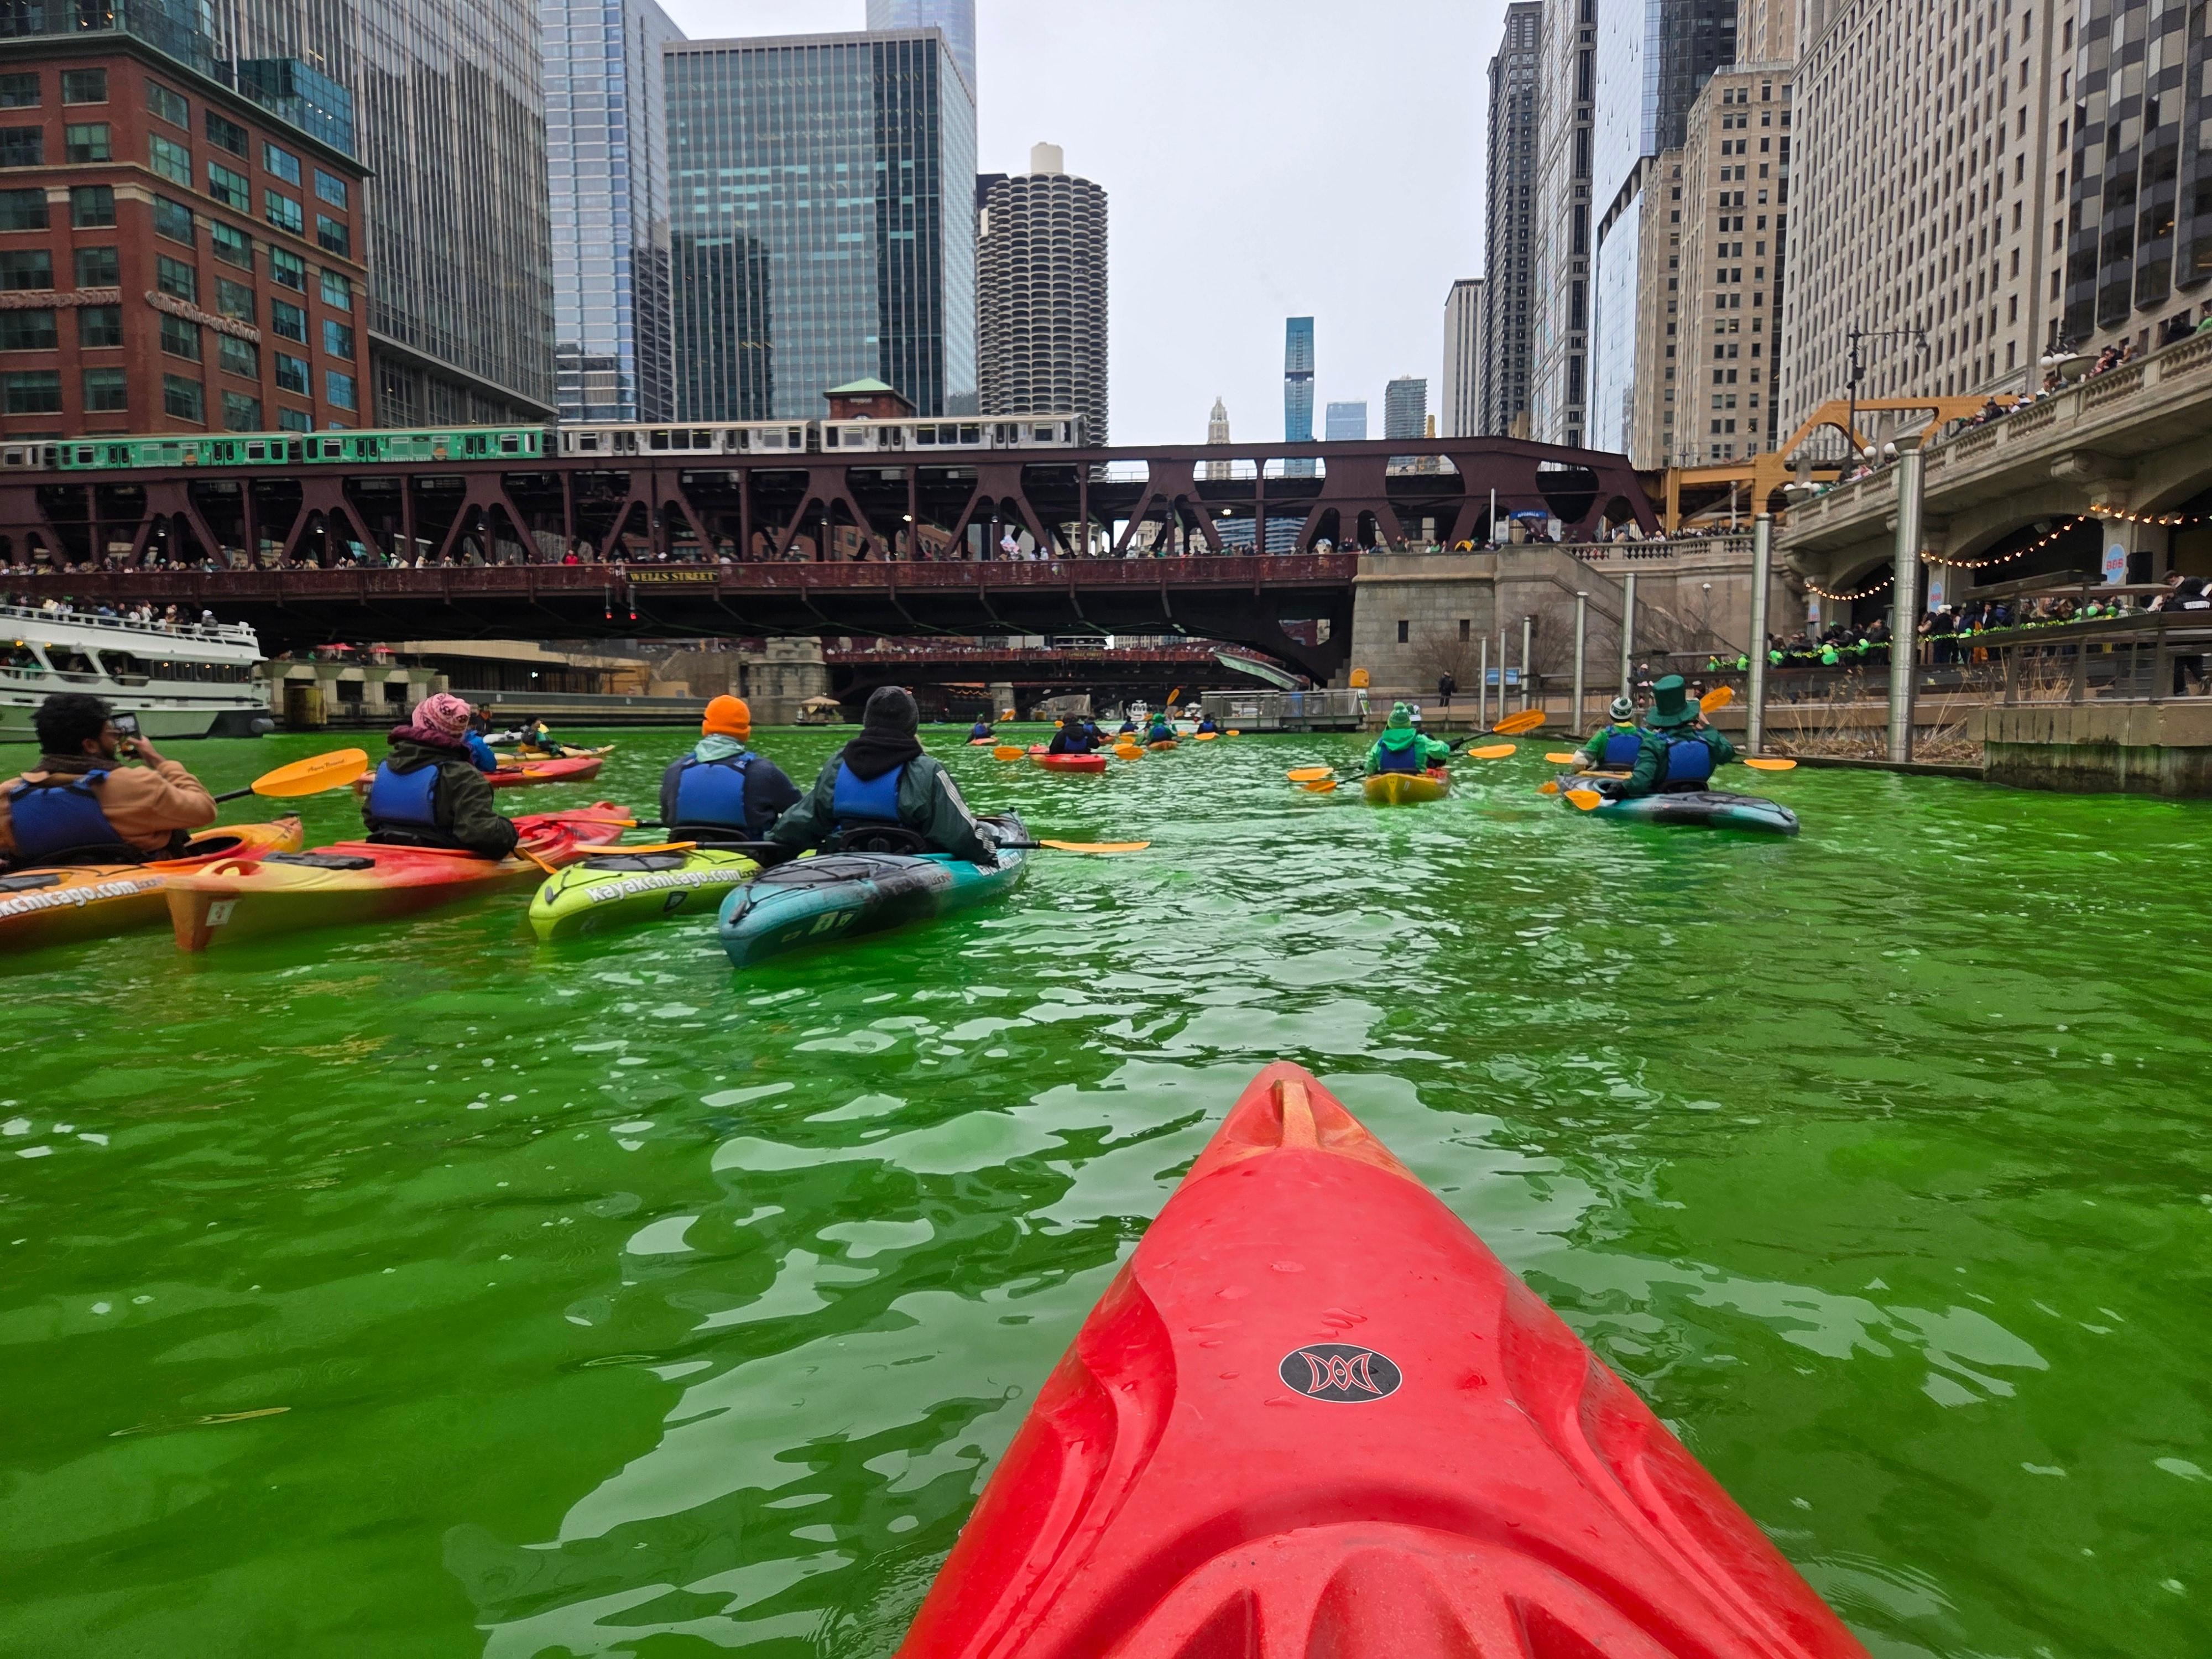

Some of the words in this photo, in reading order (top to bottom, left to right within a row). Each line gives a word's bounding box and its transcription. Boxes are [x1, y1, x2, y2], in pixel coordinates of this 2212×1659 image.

[182, 303, 229, 331] Chicago
[228, 319, 262, 344] School
[630, 572, 669, 581] WELLS
[671, 572, 717, 581] STREET
[0, 880, 139, 919] kchicago.com
[584, 869, 742, 903] kayakchicago.com
